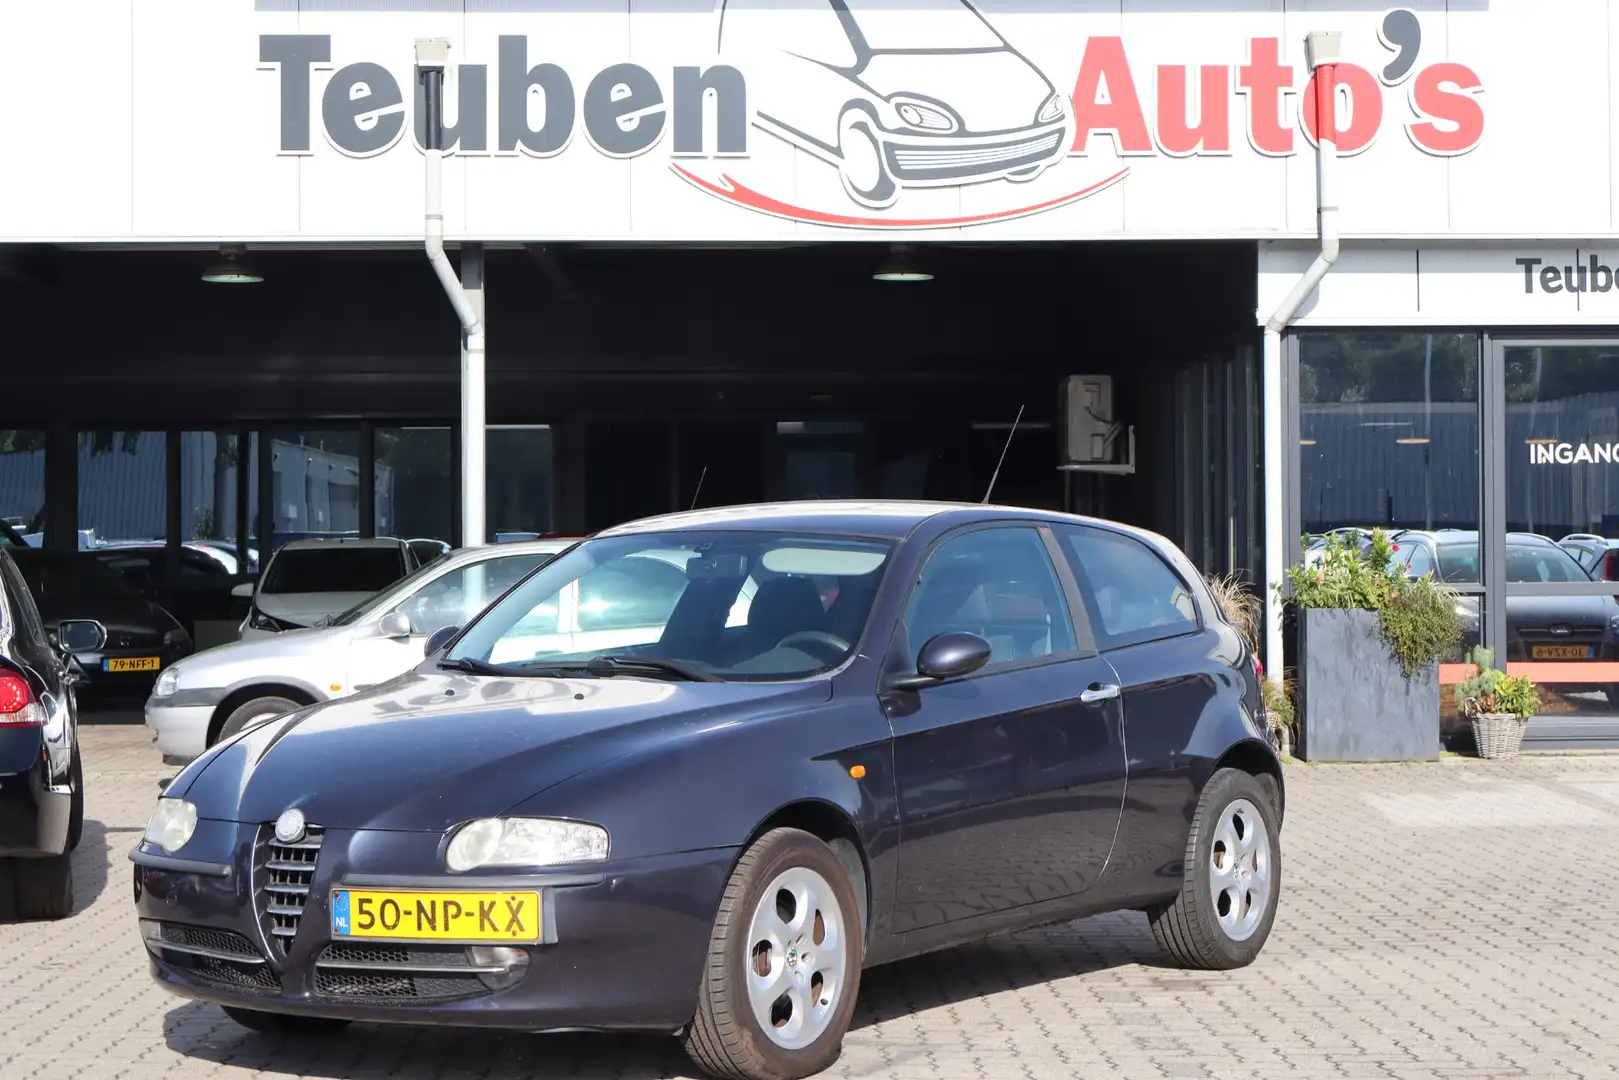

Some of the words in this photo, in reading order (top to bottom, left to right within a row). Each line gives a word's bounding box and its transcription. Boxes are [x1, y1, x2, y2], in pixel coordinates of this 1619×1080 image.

[258, 34, 748, 157] Teuben
[1068, 8, 1485, 156] Auto's
[1515, 254, 1619, 294] Teub
[113, 659, 154, 669] 79-NFF-1
[335, 916, 348, 928] NL
[357, 897, 525, 933] 50-NP-KX
